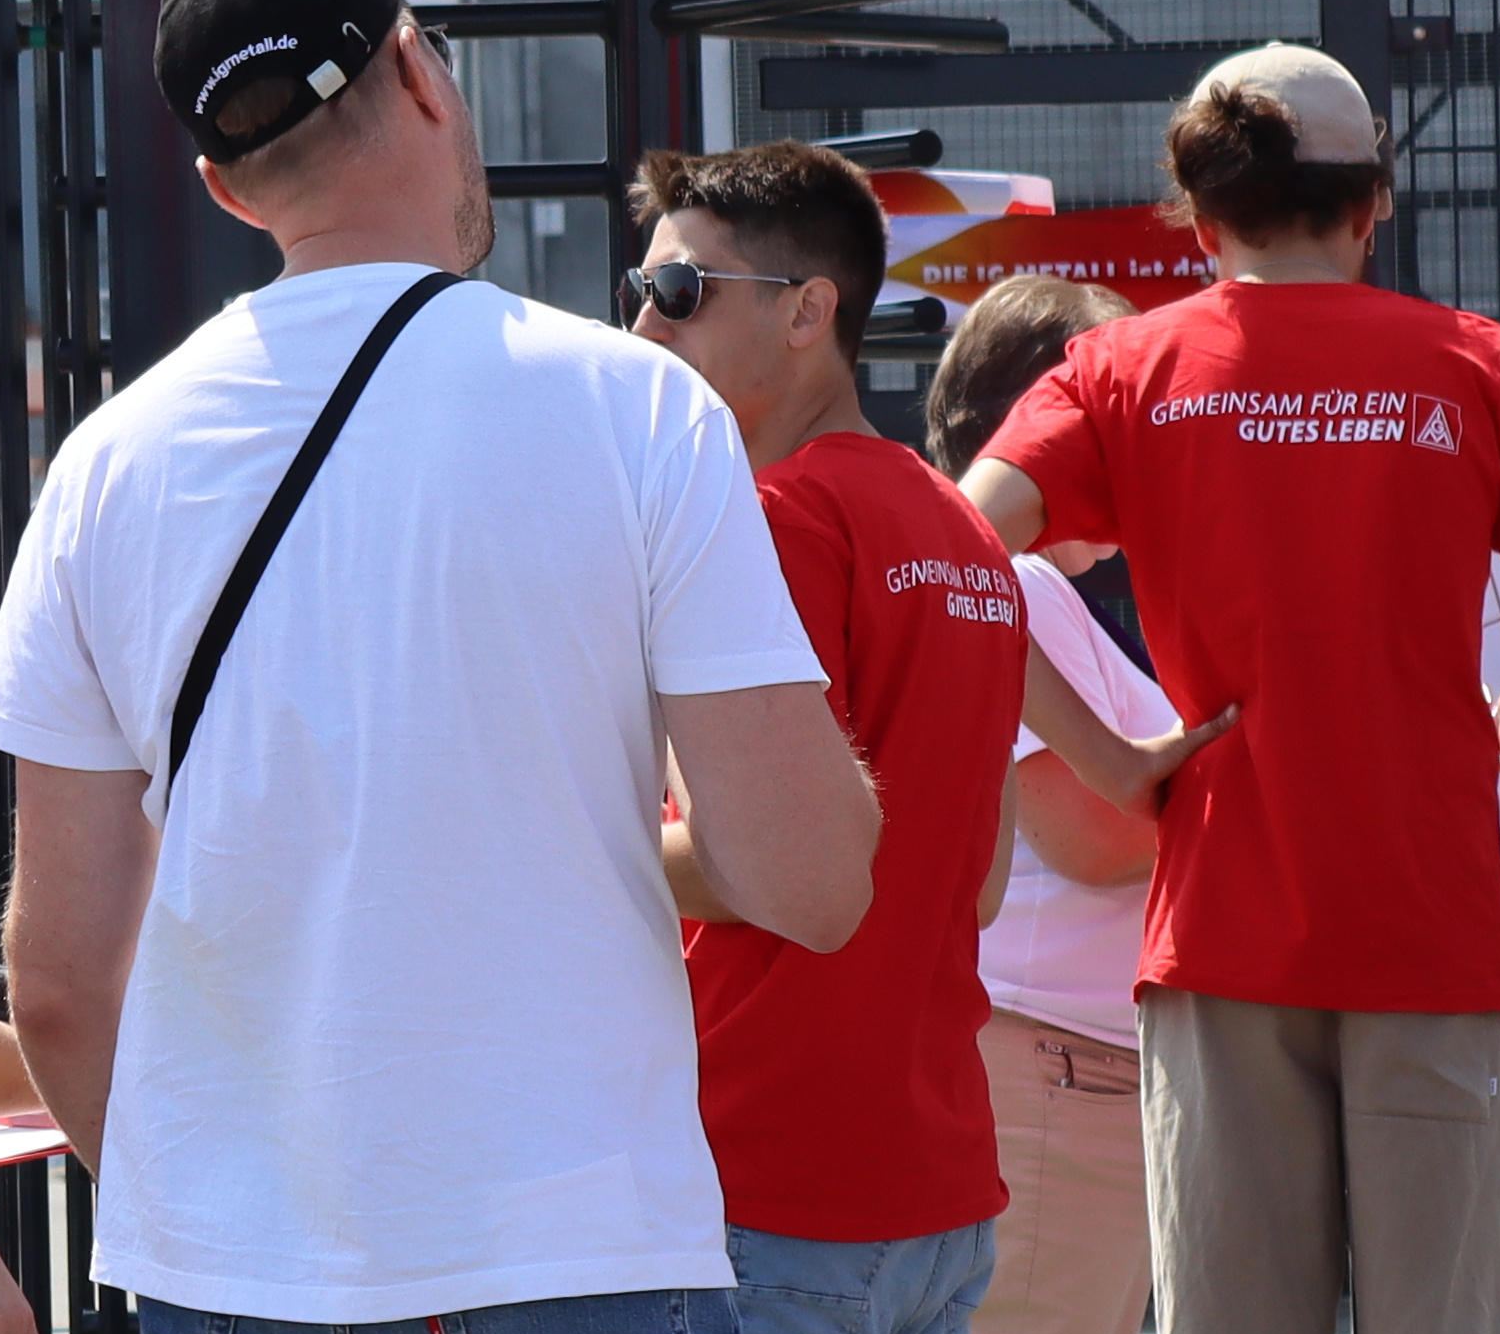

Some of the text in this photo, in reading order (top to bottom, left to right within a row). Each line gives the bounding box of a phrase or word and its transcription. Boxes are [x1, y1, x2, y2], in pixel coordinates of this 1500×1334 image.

[194, 34, 298, 114] www.igmetall.de
[922, 264, 968, 284] DIE
[1151, 388, 1407, 425] GEMEINSAM FÜR EIN
[1238, 419, 1406, 443] GUTES LEBEN
[964, 563, 992, 592] FÜR
